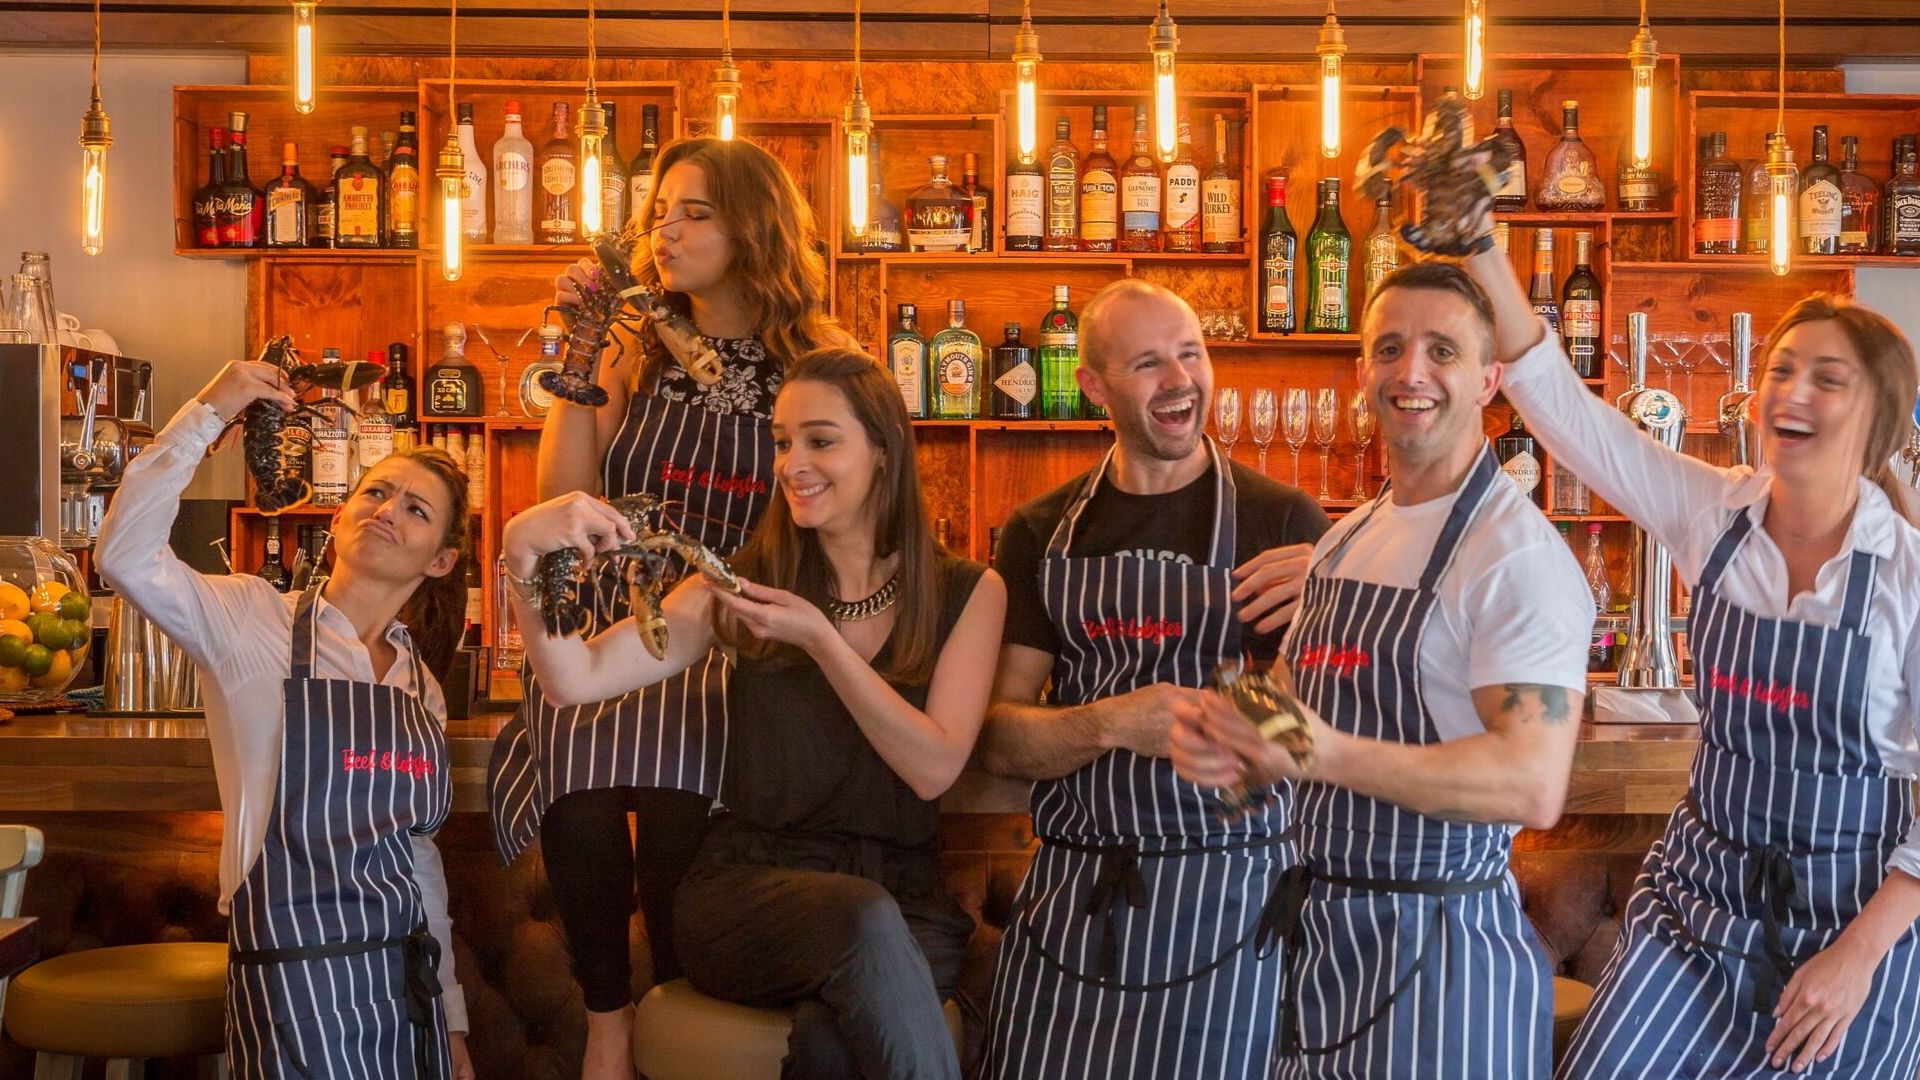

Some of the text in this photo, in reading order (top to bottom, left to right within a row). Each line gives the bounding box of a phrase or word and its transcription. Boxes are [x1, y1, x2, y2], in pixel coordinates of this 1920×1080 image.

[1169, 178, 1197, 187] PADDY
[1011, 189, 1039, 198] HAIG
[1207, 192, 1227, 203] WILD
[1808, 190, 1839, 202] TEELING
[223, 197, 254, 216] Maria
[1204, 202, 1232, 214] TURKEY
[1533, 305, 1558, 314] BOLS
[939, 351, 968, 376] PLYMOUTH
[361, 425, 391, 433] LUXARDO
[661, 460, 696, 488] Beef
[1081, 618, 1115, 640] Beef
[1127, 615, 1184, 645] Lobster
[1709, 664, 1739, 694] Beef
[341, 748, 377, 774] Beef
